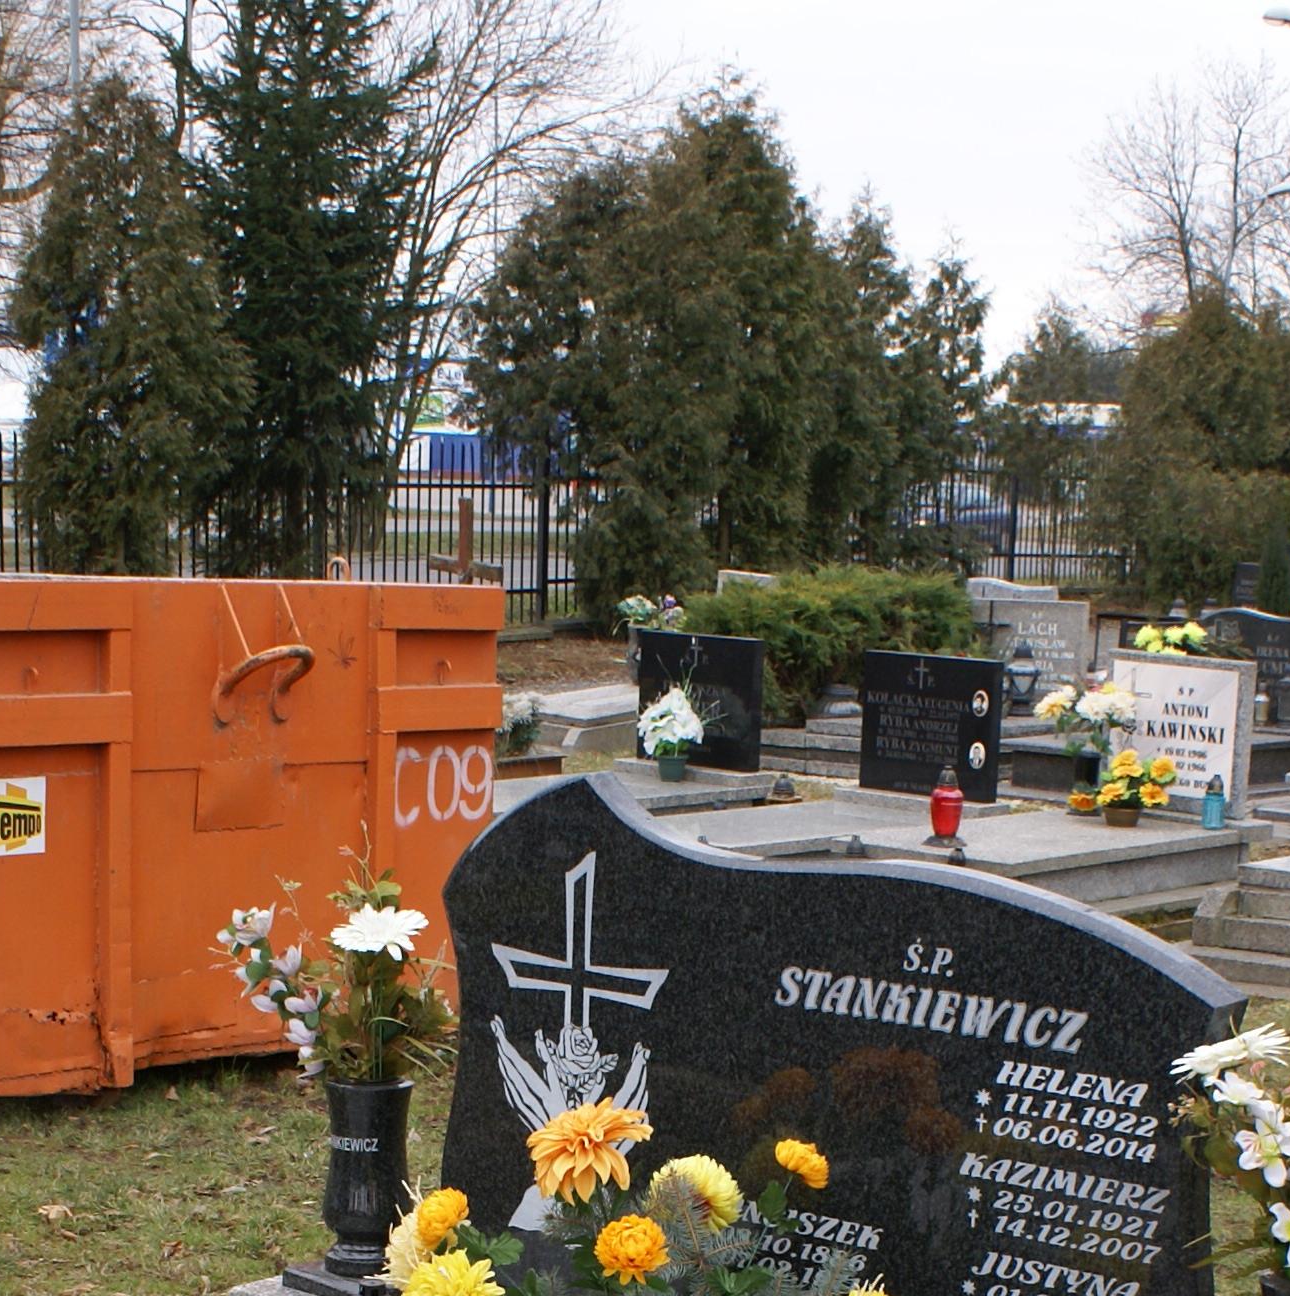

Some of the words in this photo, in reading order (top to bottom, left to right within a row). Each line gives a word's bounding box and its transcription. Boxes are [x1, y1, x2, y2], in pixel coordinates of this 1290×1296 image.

[879, 714, 910, 729] RYBA
[914, 719, 958, 733] ANDRZEJ
[1162, 702, 1209, 719] ANTONI
[876, 736, 907, 750] RYBA
[908, 739, 960, 756] ZYGMUNT
[774, 965, 1089, 1055] STANKIEWICZ
[995, 1059, 1150, 1108] HELENA
[1003, 1092, 1160, 1138] 11.11.1922
[992, 1116, 1157, 1164] 06.06.2014
[959, 1151, 1171, 1214] KAZIMIERZ
[992, 1189, 1159, 1239] 25.01.1921
[994, 1215, 1163, 1265] 14.12.2007
